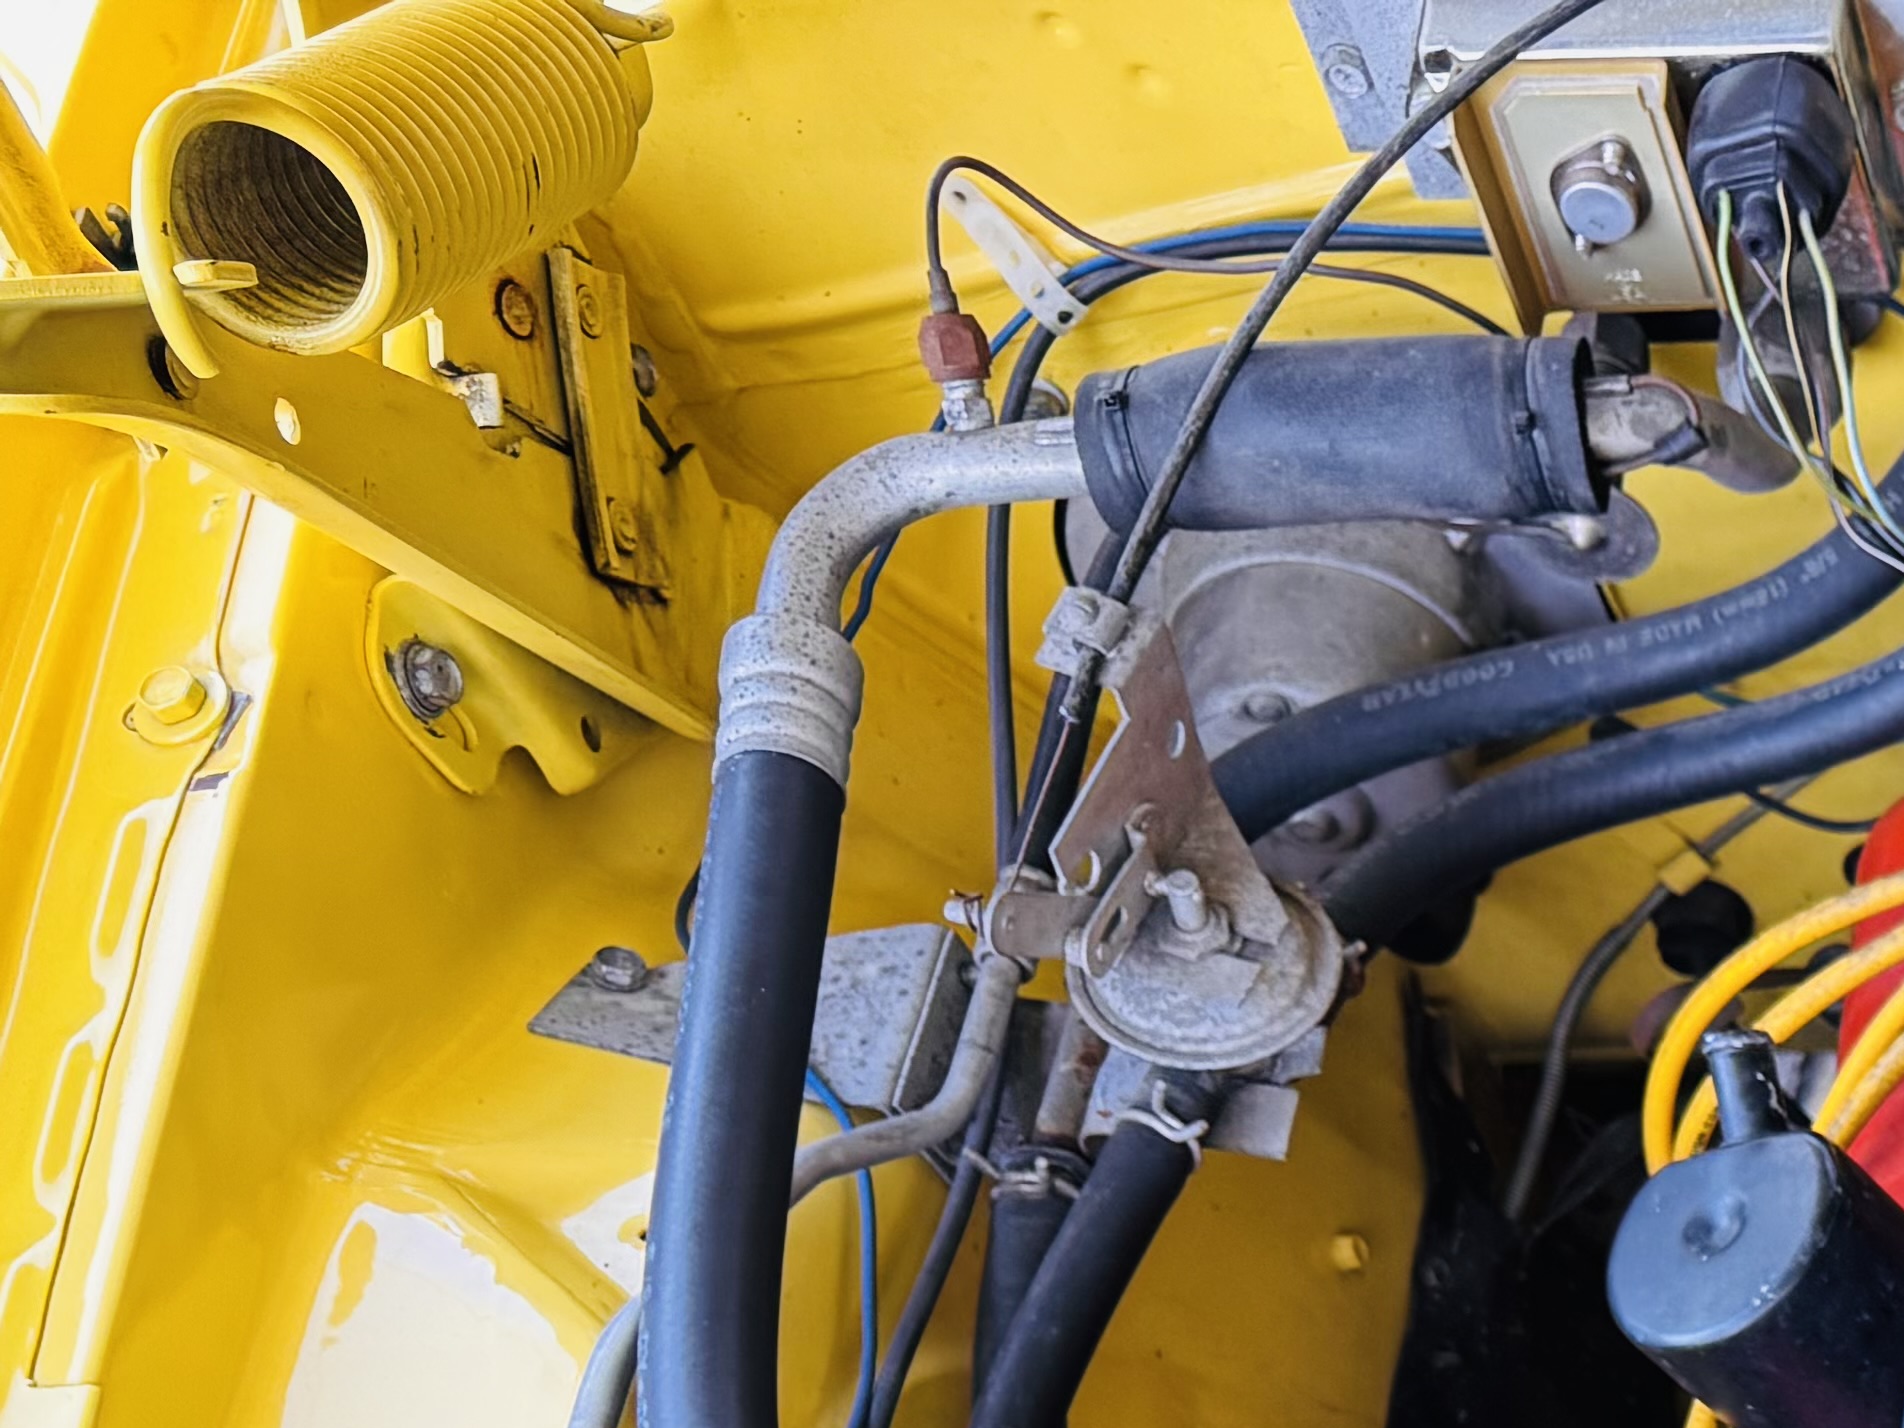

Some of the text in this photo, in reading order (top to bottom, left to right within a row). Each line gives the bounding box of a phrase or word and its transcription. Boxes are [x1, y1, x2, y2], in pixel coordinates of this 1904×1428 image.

[1635, 609, 1702, 649] MADE
[1544, 638, 1595, 668] USA
[1358, 655, 1516, 714] GOODYEAR
